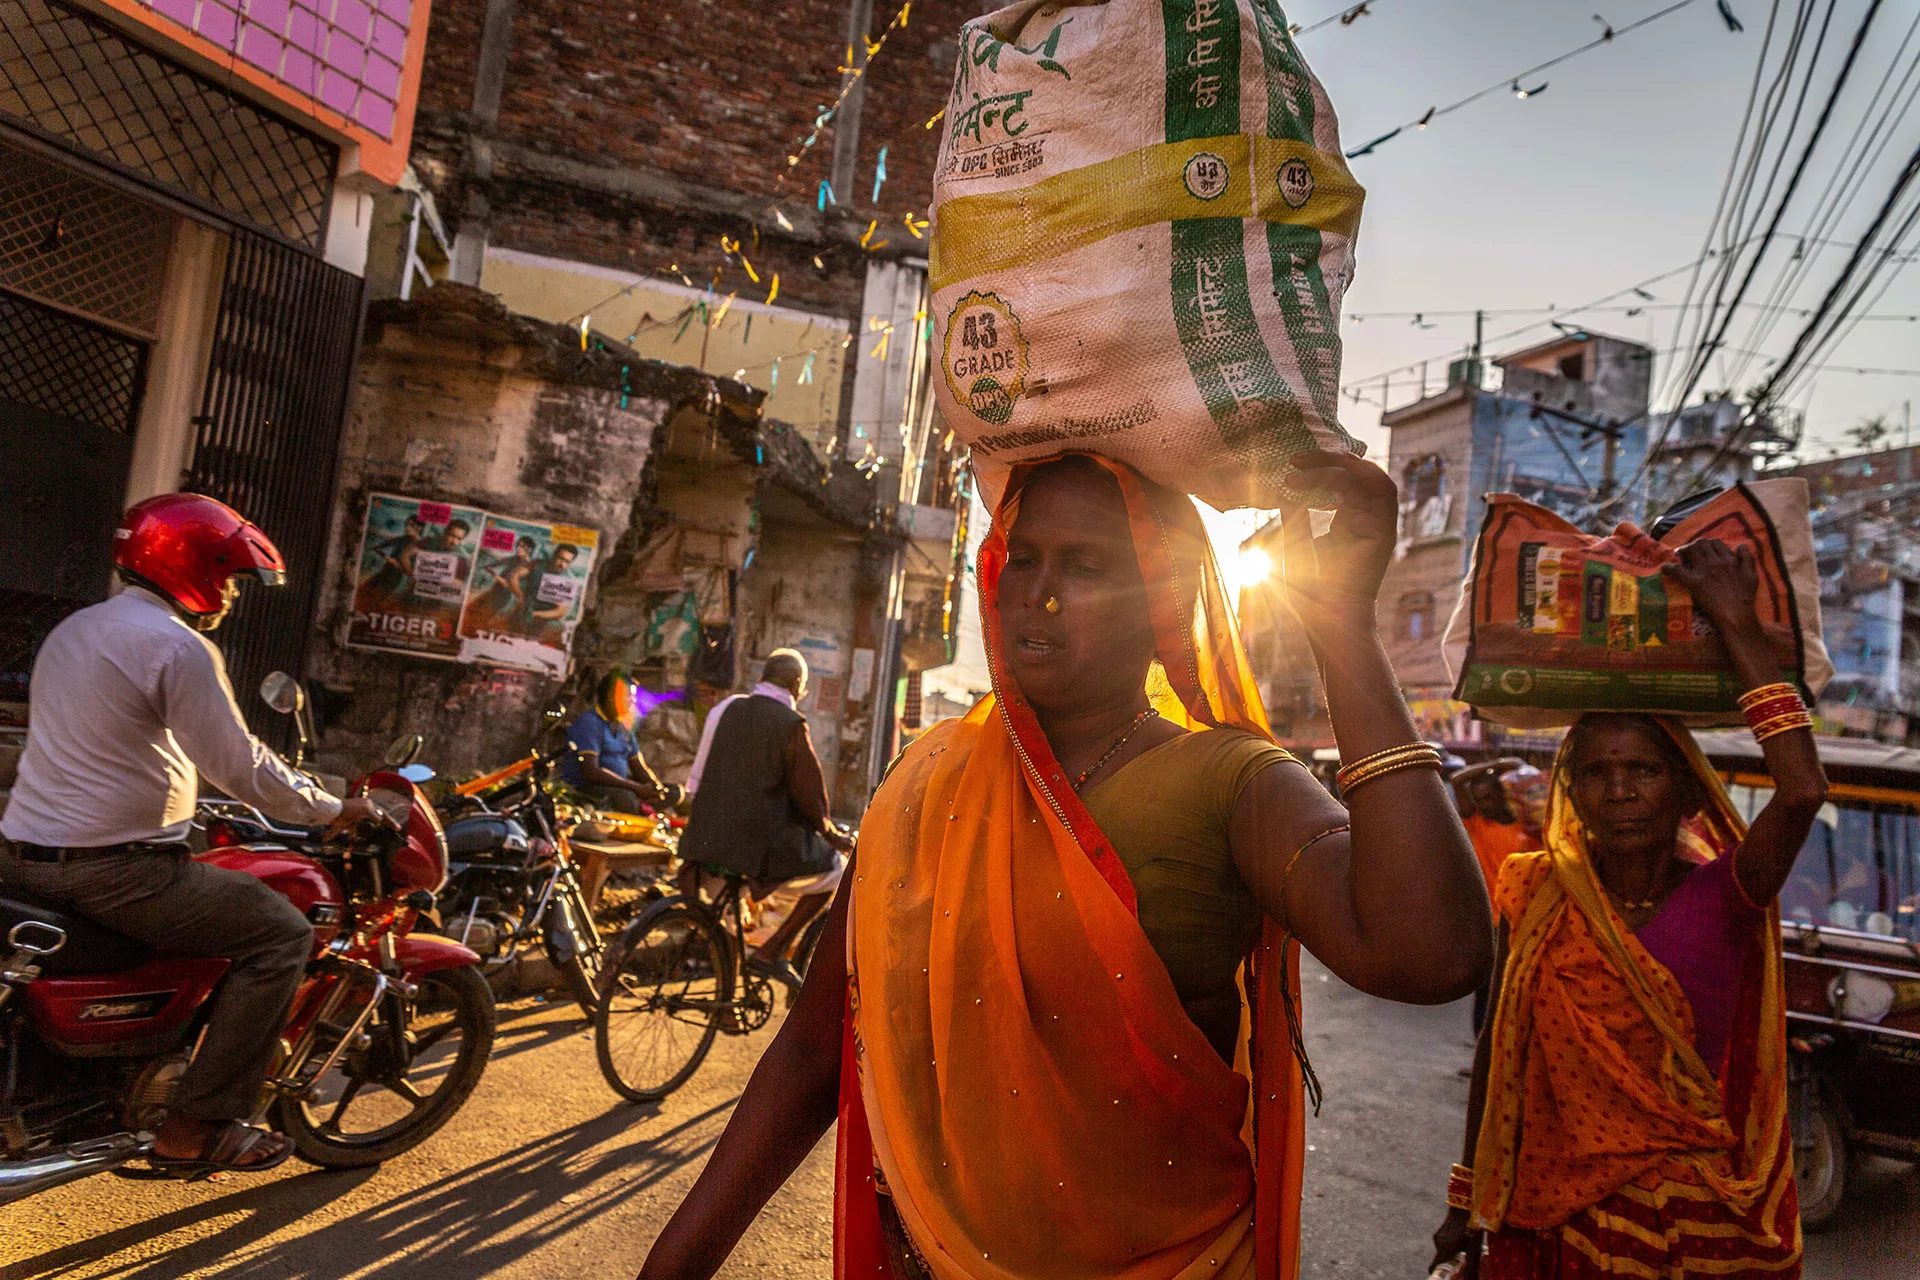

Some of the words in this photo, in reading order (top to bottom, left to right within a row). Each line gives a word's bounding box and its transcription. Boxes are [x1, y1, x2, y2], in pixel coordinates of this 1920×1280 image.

[961, 153, 987, 173] OPC
[995, 163, 1021, 179] SINCE
[1287, 166, 1307, 187] 43
[962, 312, 998, 350] 43
[953, 349, 1015, 378] GRADE
[971, 387, 1010, 411] OPC
[368, 612, 437, 637] TIGER
